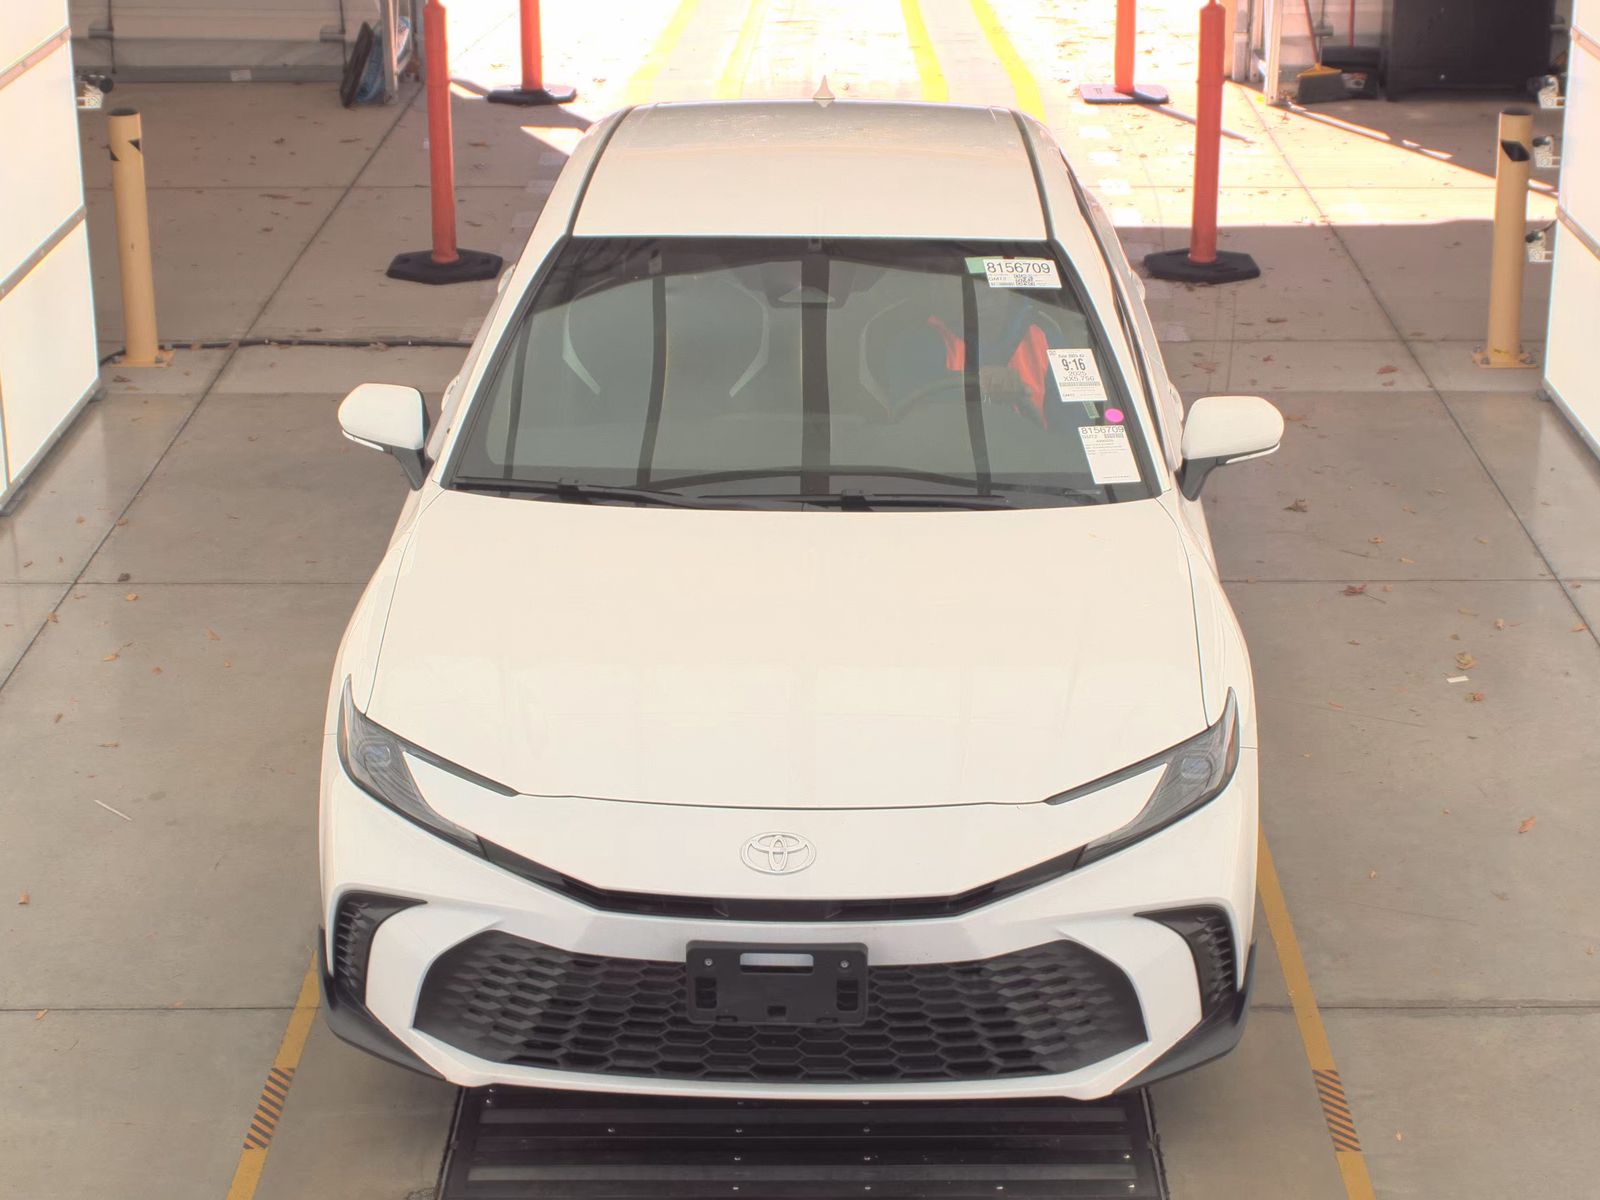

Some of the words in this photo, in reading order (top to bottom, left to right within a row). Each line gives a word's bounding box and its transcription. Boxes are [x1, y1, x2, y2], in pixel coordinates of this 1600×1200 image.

[986, 262, 1051, 274] 8156709
[1061, 358, 1086, 371] 9:16
[1081, 425, 1124, 435] 8156709
